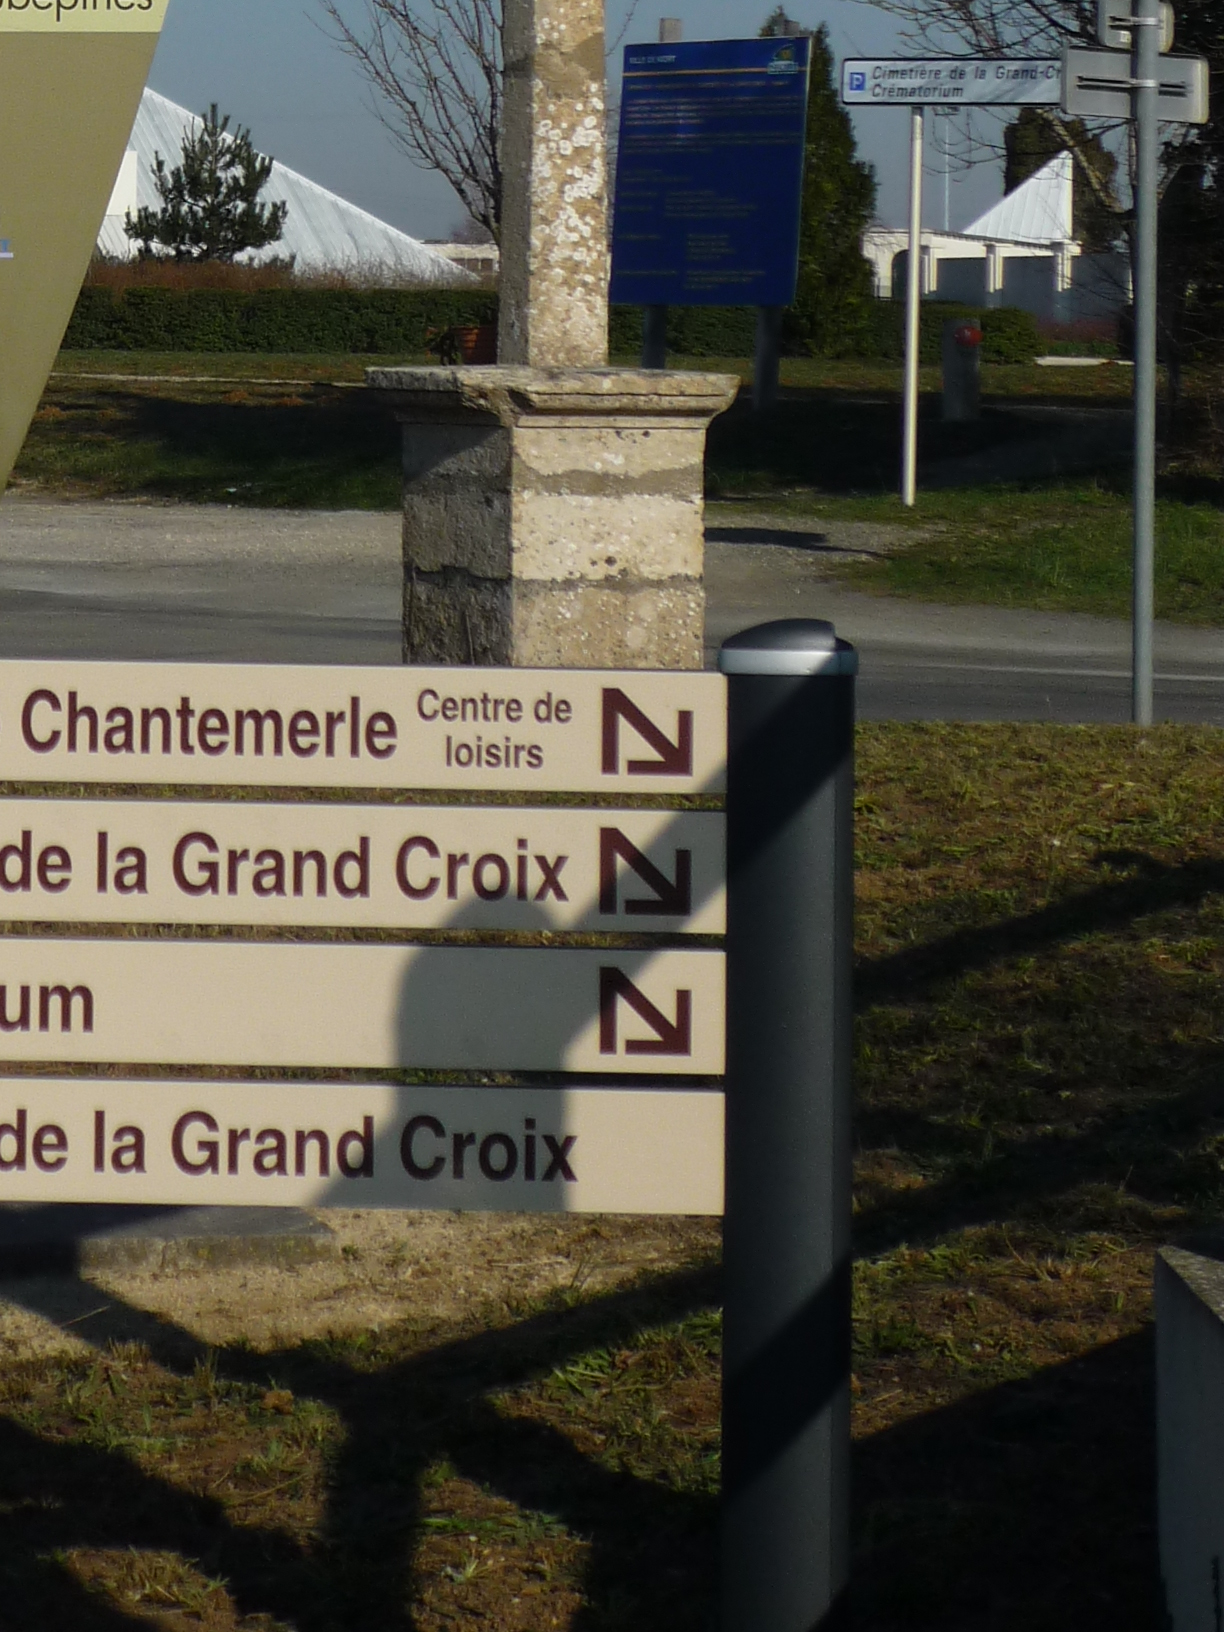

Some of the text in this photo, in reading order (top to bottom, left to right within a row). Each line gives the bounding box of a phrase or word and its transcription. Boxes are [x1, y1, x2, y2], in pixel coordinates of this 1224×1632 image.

[872, 65, 1062, 80] Cimetière de la Grand-Cr
[871, 83, 964, 98] Crématorium
[417, 688, 572, 723] Centre de
[21, 688, 398, 759] Chantemerle
[446, 735, 543, 768] loisirs
[97, 831, 148, 895] la
[172, 831, 370, 899] Grand
[395, 835, 569, 901] Croix
[94, 1110, 146, 1174] la
[171, 1110, 374, 1180] Grand
[400, 1115, 578, 1182] Croix
